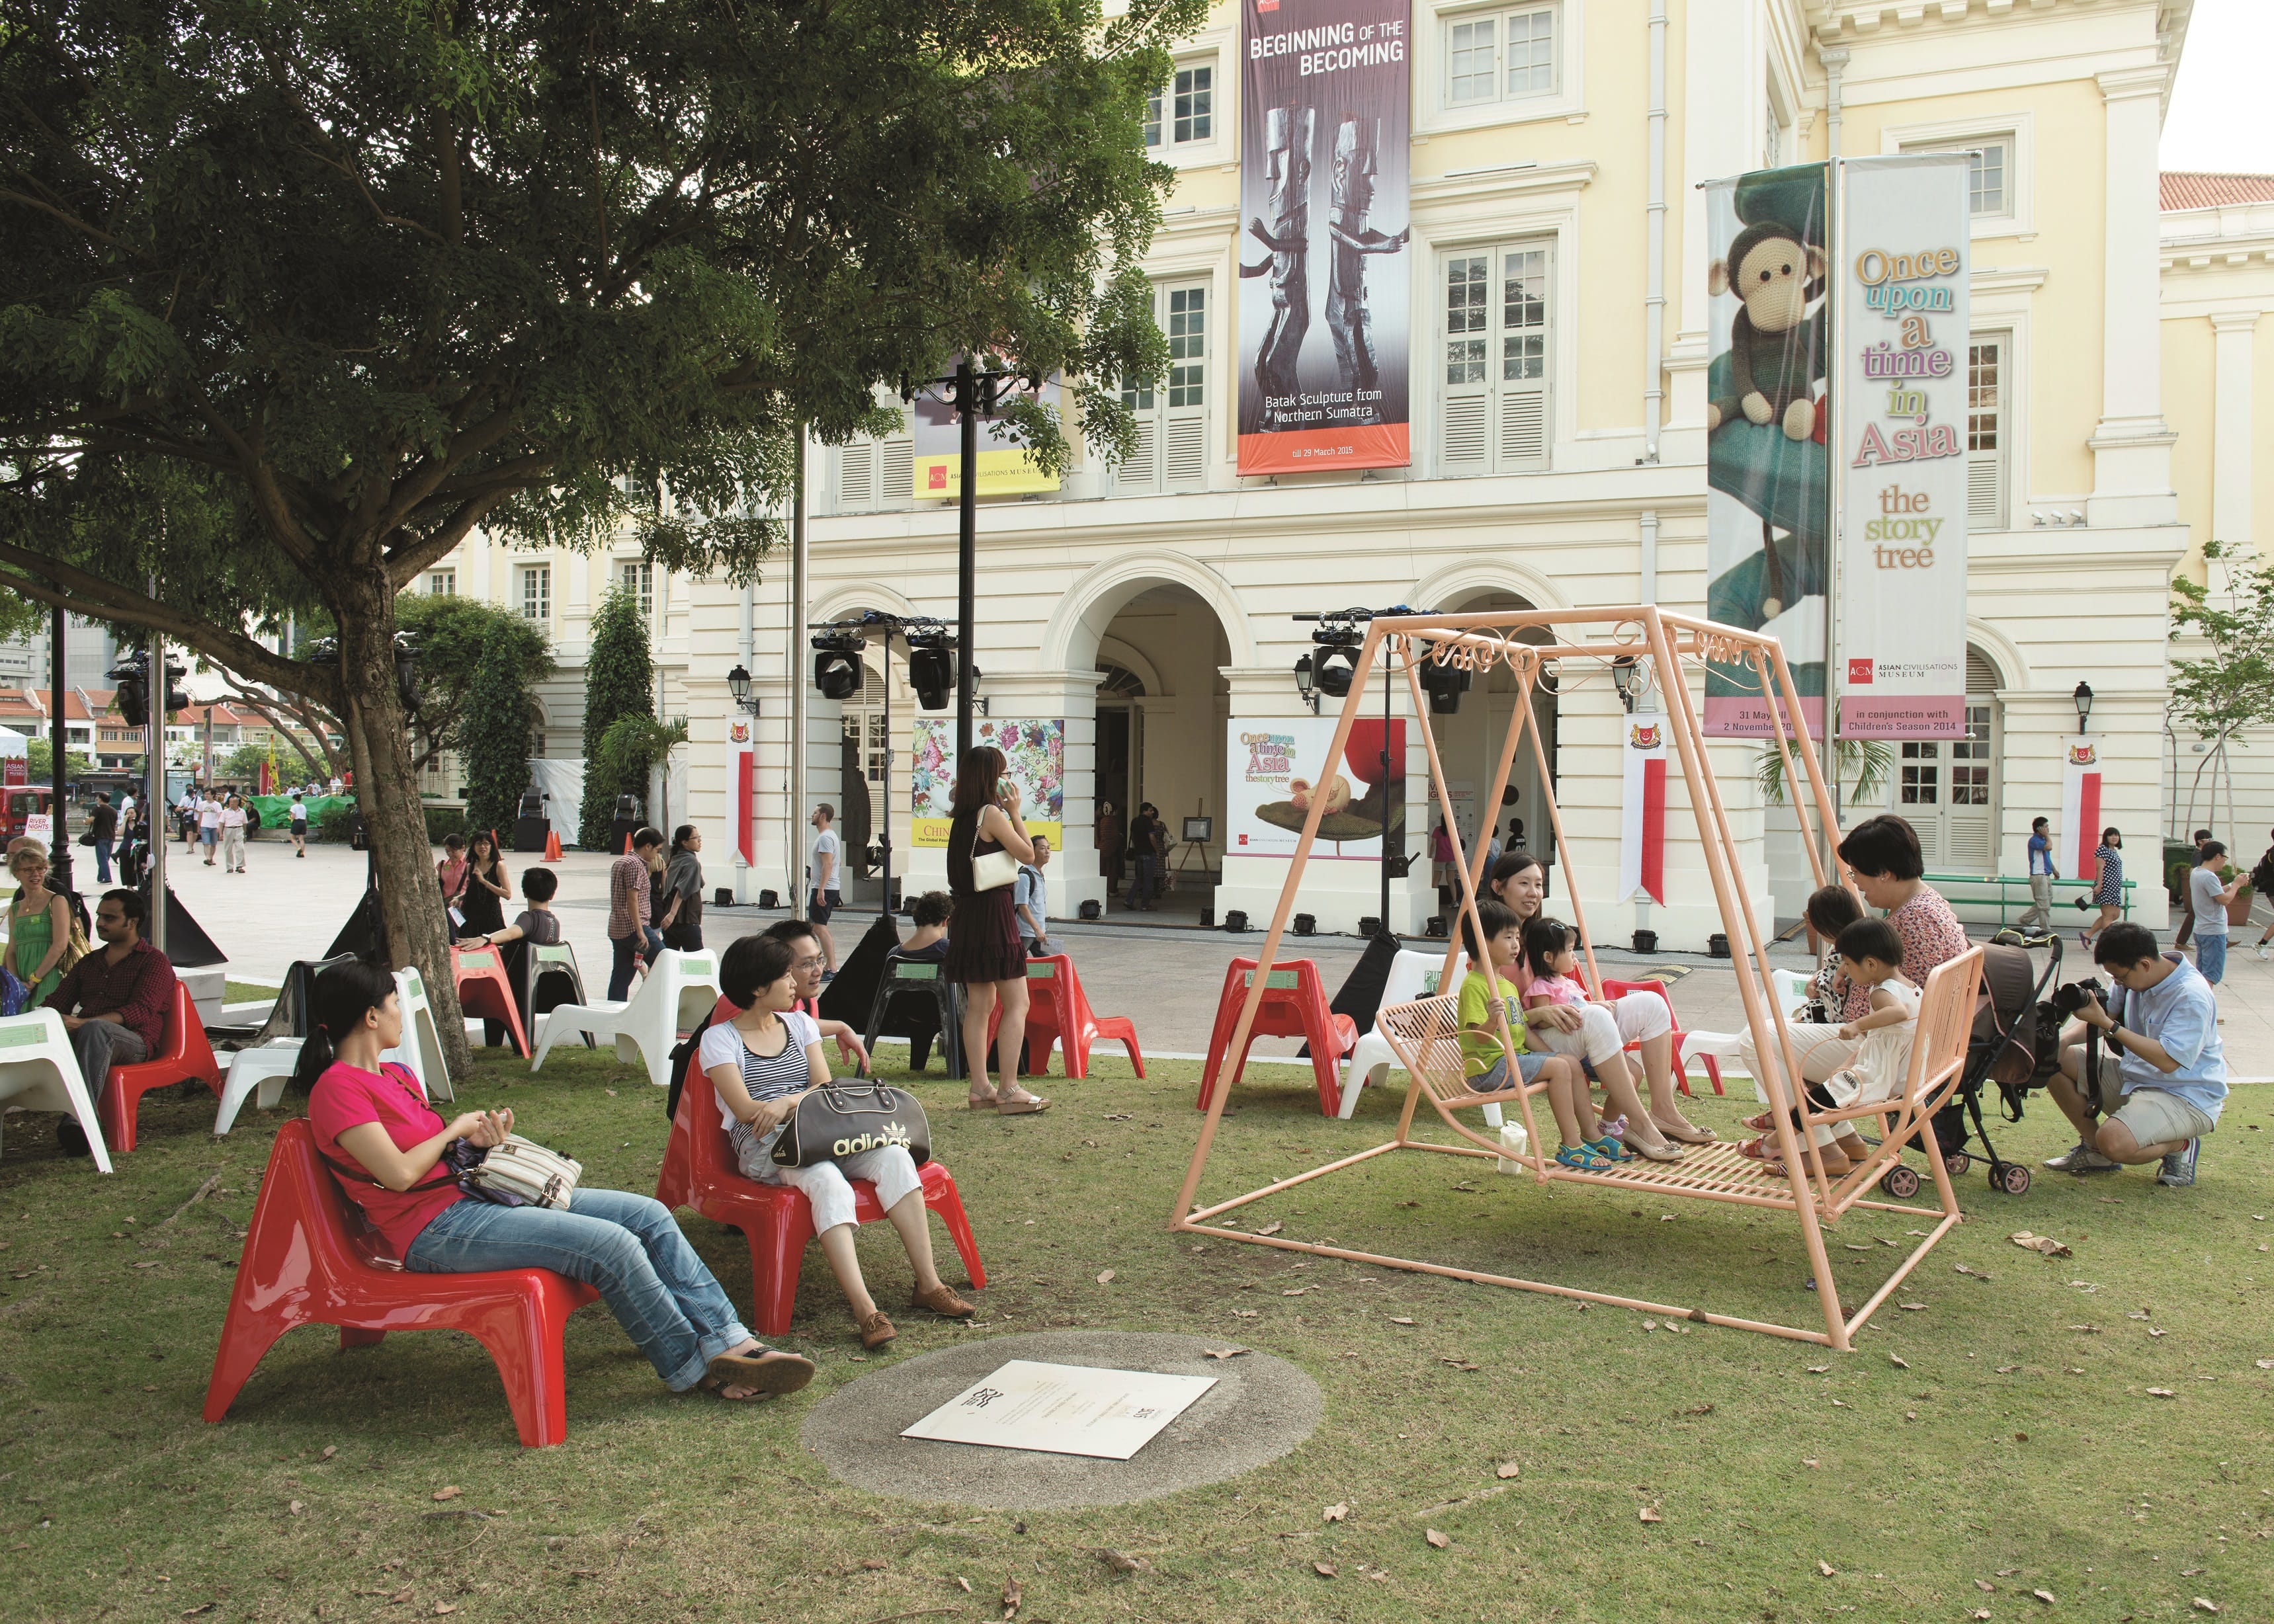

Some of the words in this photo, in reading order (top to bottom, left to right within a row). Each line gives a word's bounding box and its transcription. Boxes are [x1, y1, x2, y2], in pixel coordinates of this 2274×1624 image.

[1250, 22, 1353, 59] BEGINNING
[1359, 24, 1374, 40] OF
[1379, 20, 1404, 38] THE
[1300, 40, 1404, 76] BECOMING
[1855, 249, 1958, 284] Once
[1865, 285, 1951, 315] upon
[1900, 315, 1931, 348] a
[1861, 341, 1951, 378] time
[1266, 395, 1296, 408] Batak
[1300, 391, 1353, 407] Sculpture
[1357, 388, 1382, 401] from
[1886, 380, 1925, 416] in
[1274, 409, 1322, 423] Northern
[1327, 406, 1372, 419] Sumatra
[1851, 415, 1959, 467] Asia
[1292, 449, 1302, 458] till
[1304, 448, 1312, 457] 29
[1314, 447, 1335, 456] March
[1337, 446, 1353, 455] 2015
[930, 473, 947, 482] ACM
[1879, 485, 1929, 514] the
[1866, 515, 1943, 546] story
[1873, 544, 1934, 569] tree
[1850, 667, 1873, 676] ACM
[1740, 711, 1749, 719] 31
[1753, 711, 1771, 721] May
[1868, 710, 1923, 720] conjunction
[1849, 722, 1893, 731] Children's
[1896, 722, 1930, 731] Season
[1933, 722, 1956, 731] 2014
[1240, 732, 1269, 745] Once
[1269, 734, 1294, 745] upon
[1250, 743, 1257, 753] a
[1259, 742, 1283, 754] time
[1283, 744, 1296, 758] in
[1245, 752, 1290, 773] Asia
[924, 825, 950, 836] CHIN
